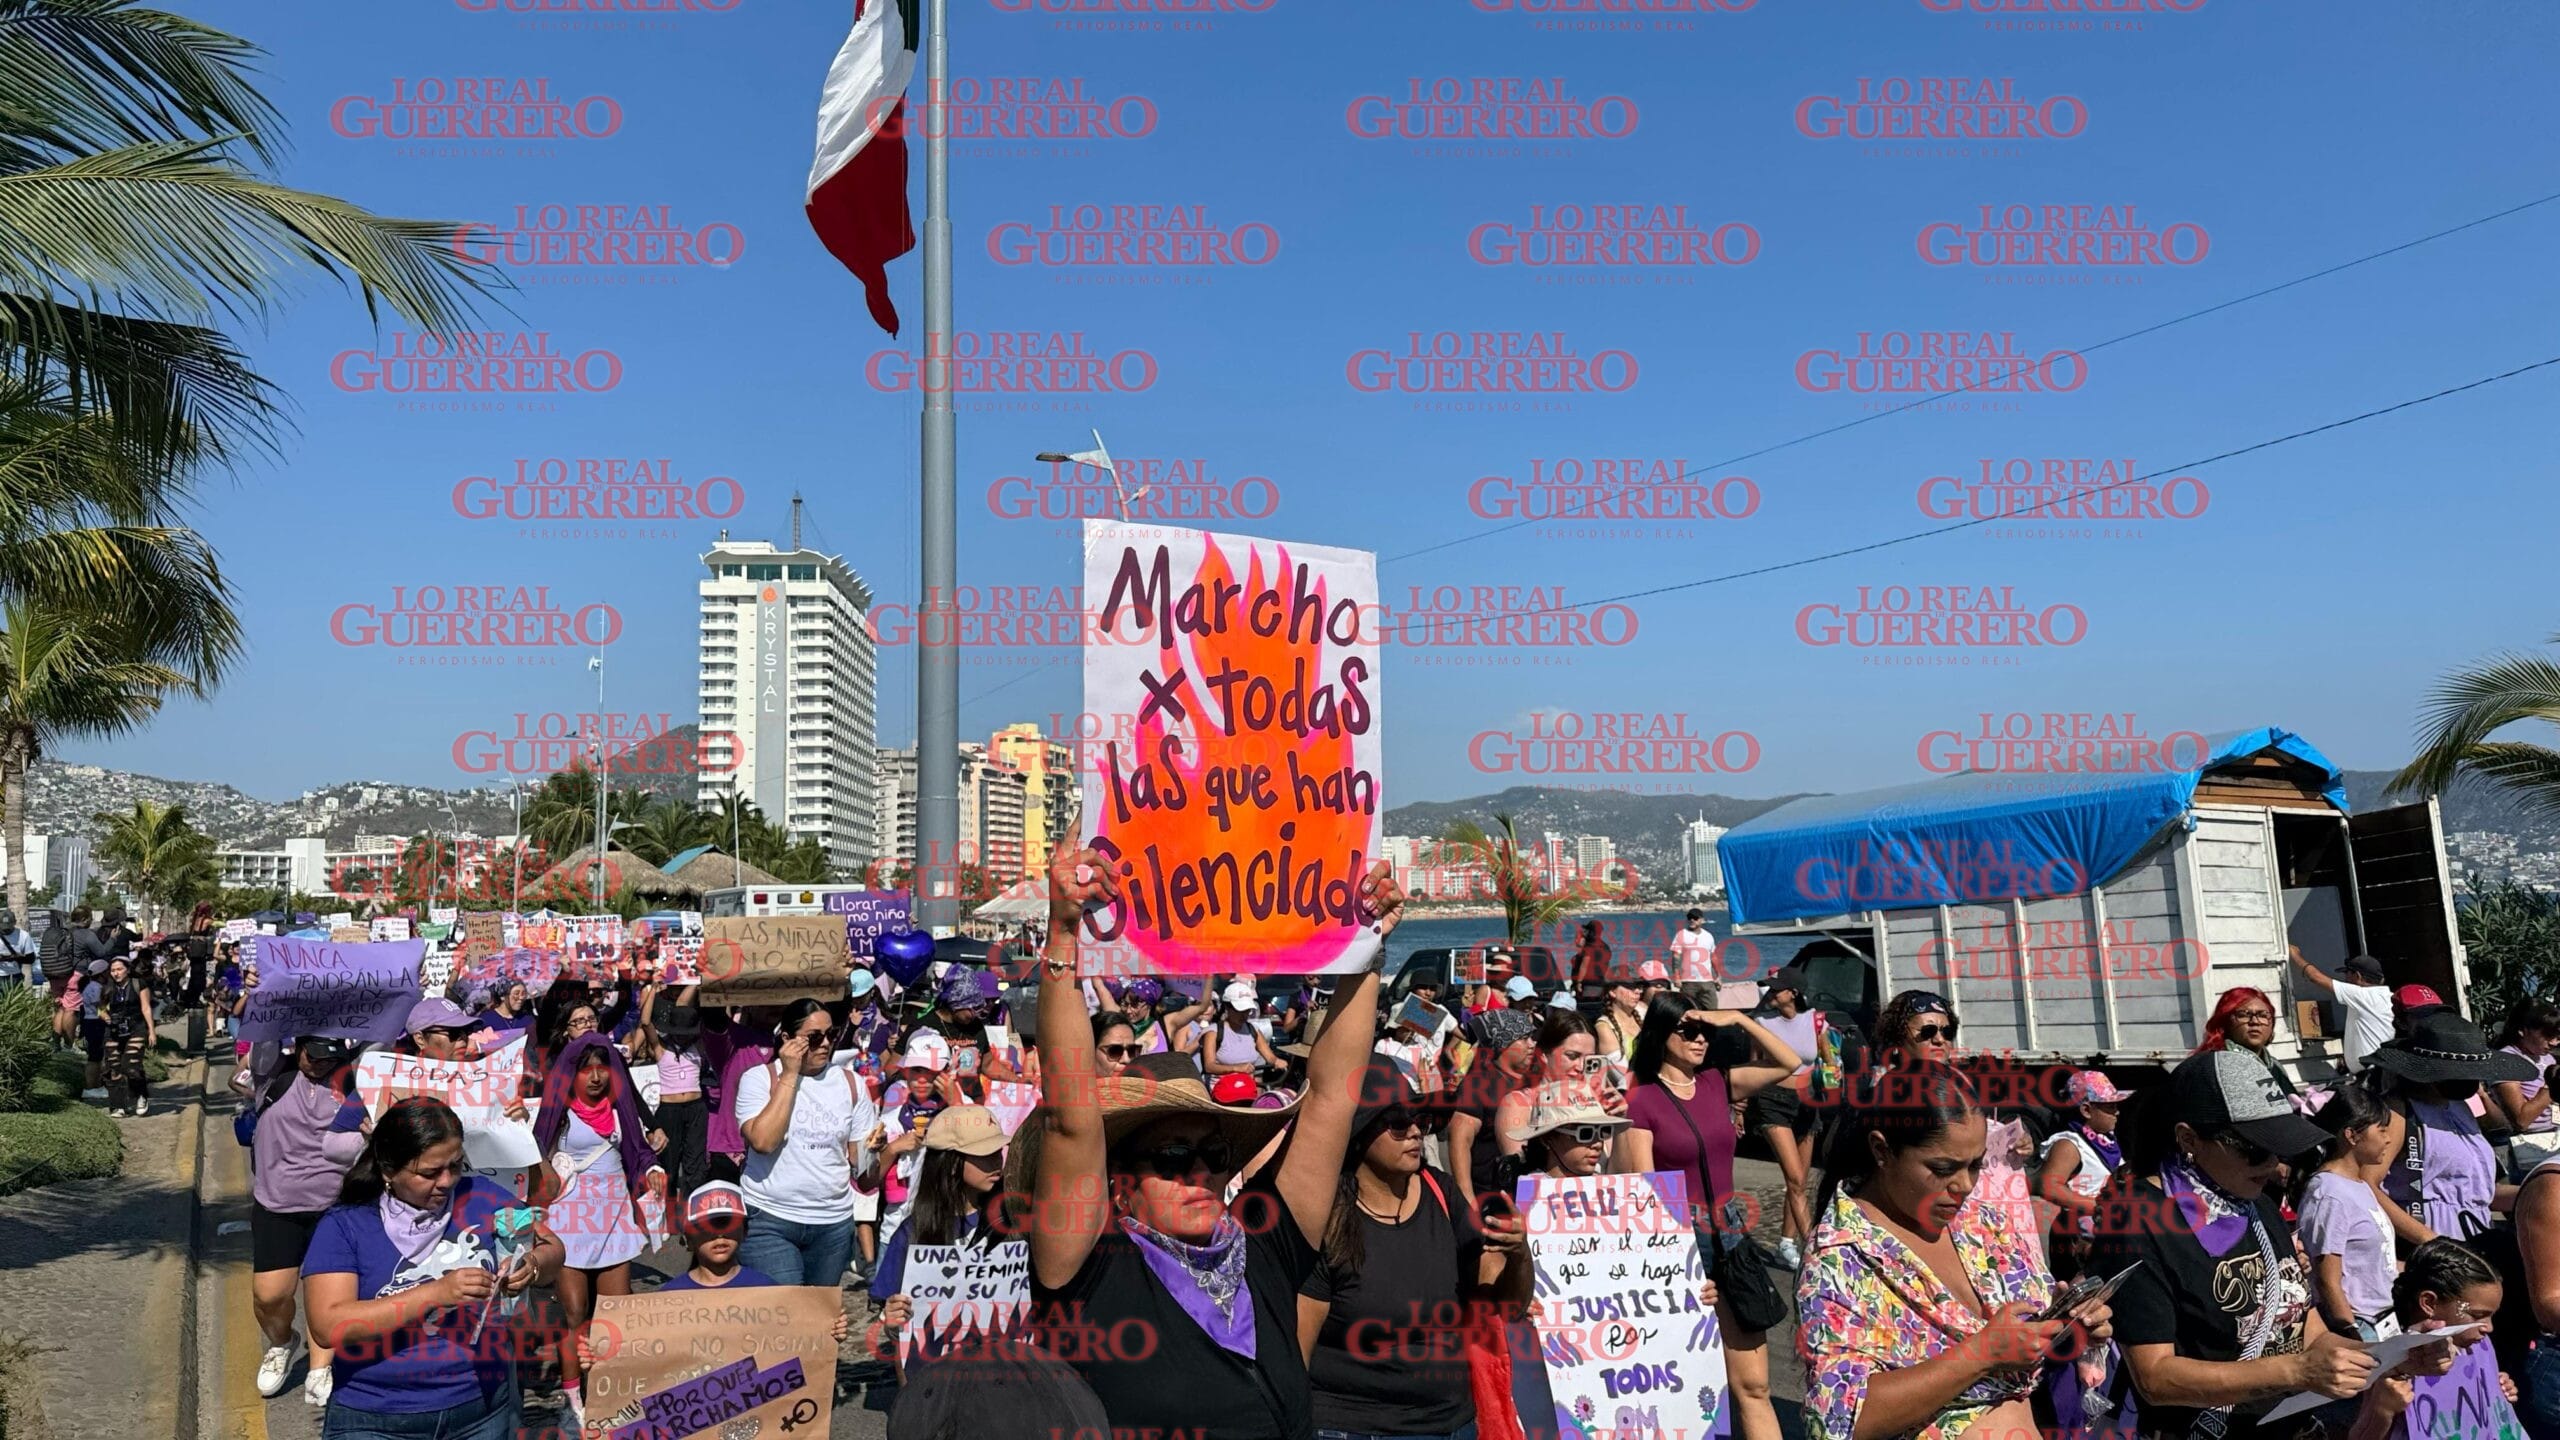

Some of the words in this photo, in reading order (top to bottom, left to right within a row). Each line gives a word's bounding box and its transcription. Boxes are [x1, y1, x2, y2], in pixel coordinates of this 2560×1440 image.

[1100, 545, 1361, 649] Marcho
[764, 606, 778, 713] KRYSTAL
[1206, 763, 1278, 831] que
[1287, 752, 1375, 815] han
[1083, 822, 1382, 943] Silenciad
[830, 896, 881, 911] Llorar
[875, 908, 906, 921] niña
[717, 921, 769, 946] LAS
[777, 926, 839, 955] NIÑAS
[867, 922, 882, 936] el
[268, 942, 350, 969] NUNCA
[739, 950, 784, 972] NO
[798, 950, 827, 971] SE
[290, 969, 380, 990] TENDRÁN
[388, 967, 414, 988] LA
[339, 1016, 371, 1029] VEZ
[381, 1056, 489, 1085] TODAS
[1548, 1188, 1619, 1220] FELIZ
[1568, 1237, 1600, 1256] ser
[1618, 1230, 1633, 1252] el
[914, 1249, 961, 1264] UNA
[1560, 1263, 1590, 1284] que
[1608, 1265, 1629, 1278] se
[1641, 1259, 1685, 1286] haga
[911, 1285, 956, 1299] CON
[966, 1284, 998, 1299] SU
[626, 1305, 790, 1330] ENTERRARNOS
[1569, 1288, 1702, 1323] JUSTICIA
[691, 1336, 724, 1356] NO
[1600, 1361, 1684, 1398] TODAS
